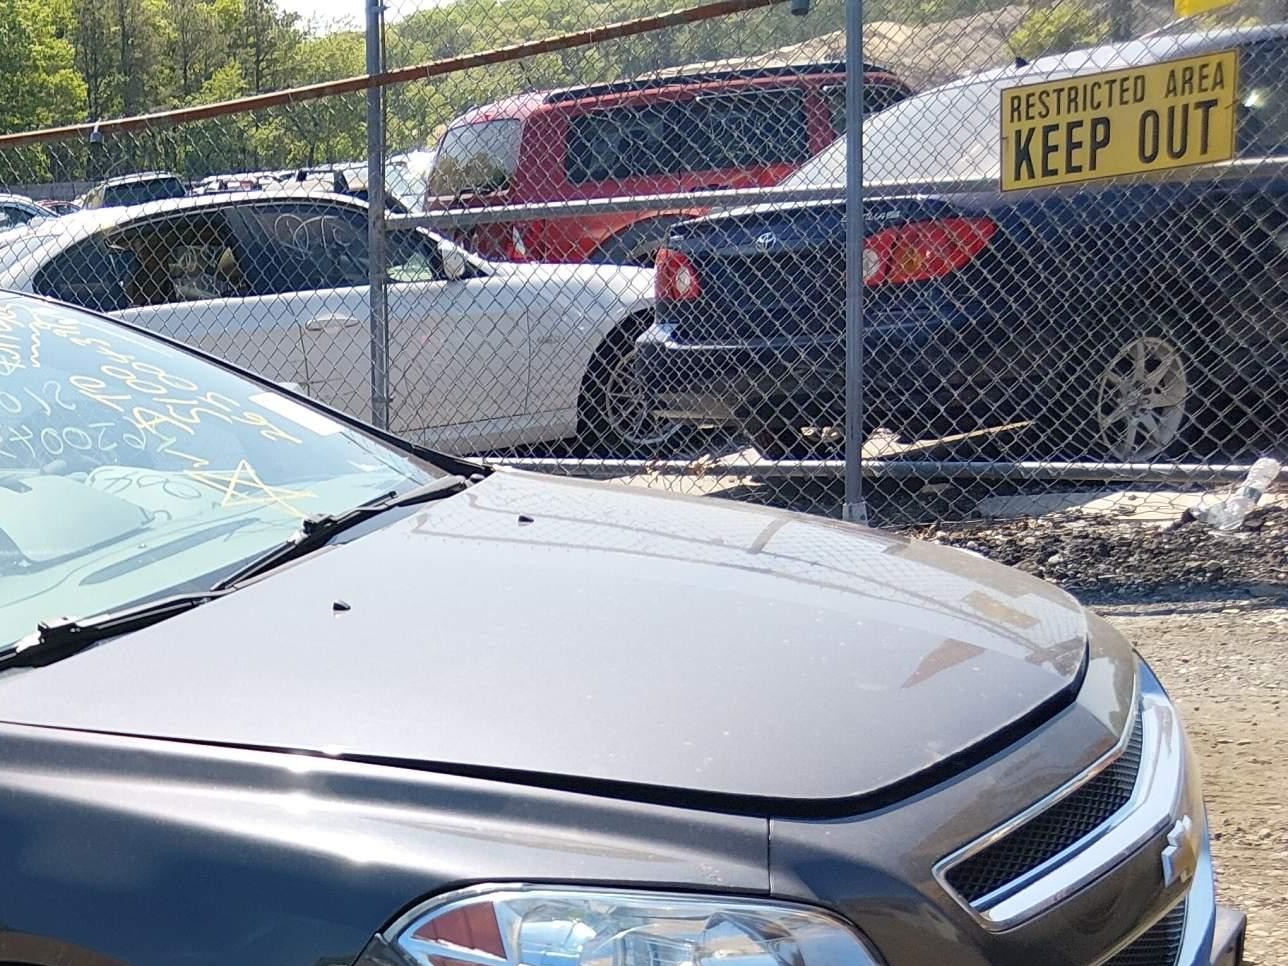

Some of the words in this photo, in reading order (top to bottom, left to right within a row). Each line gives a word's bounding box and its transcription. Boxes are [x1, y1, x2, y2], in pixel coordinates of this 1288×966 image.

[1009, 74, 1147, 124] RESTRICTED
[1163, 61, 1226, 99] AREA
[1013, 116, 1111, 182] KEEP
[1138, 98, 1219, 165] OUT
